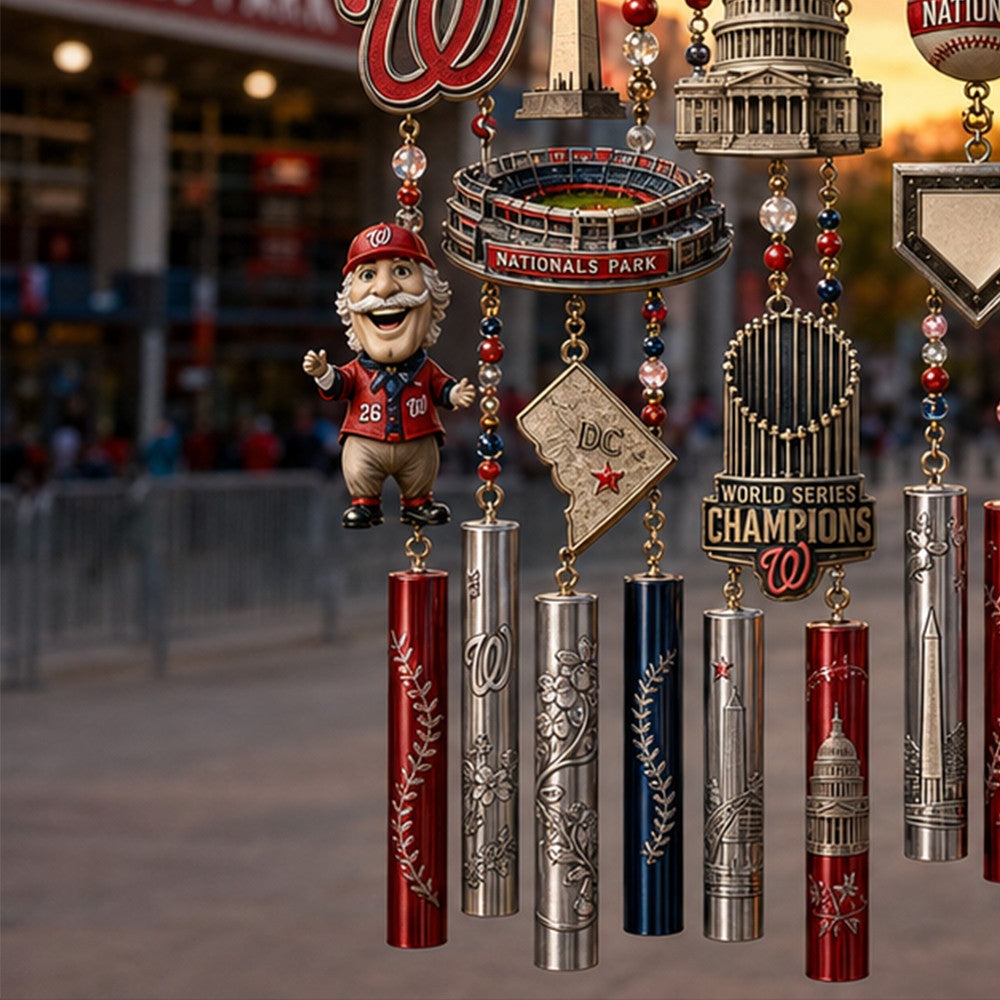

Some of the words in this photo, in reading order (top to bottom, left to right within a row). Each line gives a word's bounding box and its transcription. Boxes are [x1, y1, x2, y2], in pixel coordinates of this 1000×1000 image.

[366, 226, 392, 248] W
[496, 252, 599, 274] NATIONALS
[608, 256, 657, 274] PARK
[359, 402, 382, 422] 26
[577, 420, 625, 457] DC
[720, 484, 786, 504] WORLD
[791, 484, 857, 503] SERIES
[707, 506, 873, 545] CHAMPIONS
[759, 541, 812, 595] W
[464, 624, 512, 696] W
